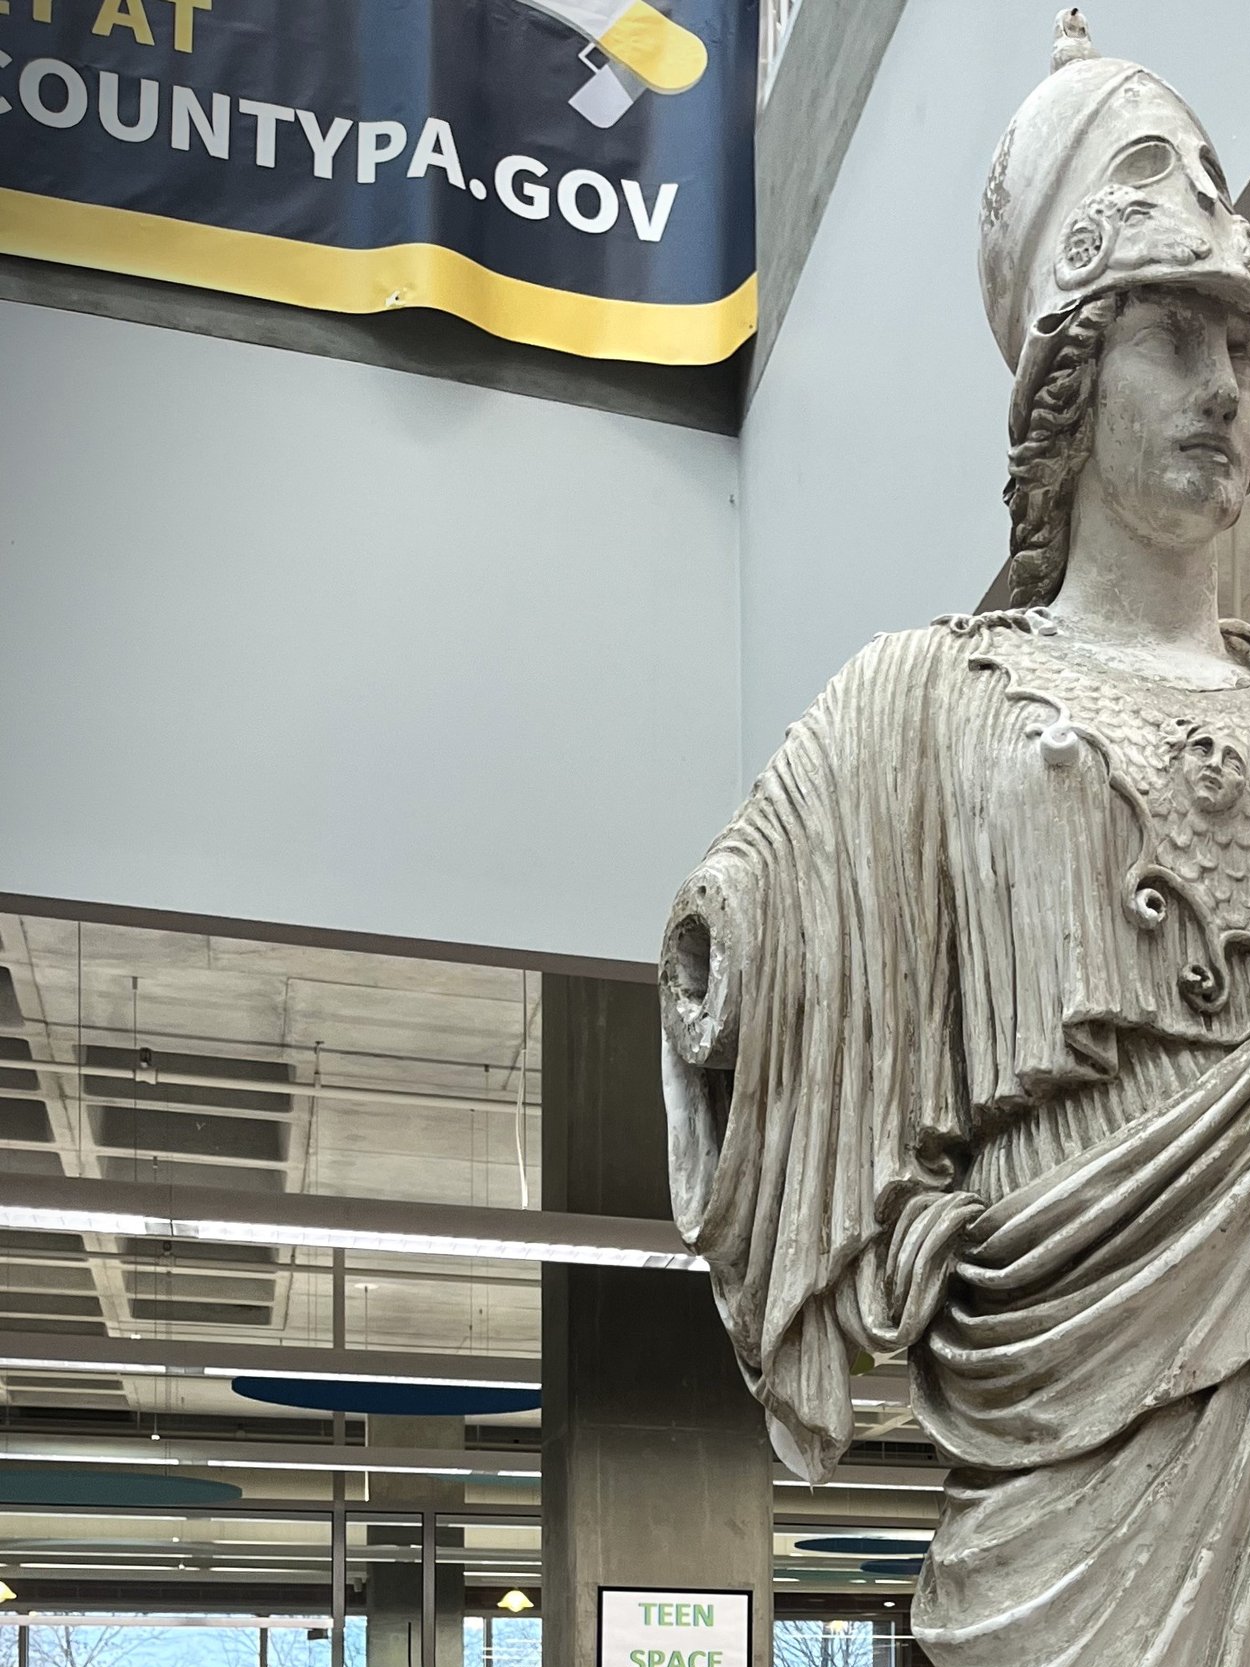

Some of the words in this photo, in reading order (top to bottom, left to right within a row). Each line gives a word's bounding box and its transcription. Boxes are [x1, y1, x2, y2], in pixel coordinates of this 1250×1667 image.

[92, 0, 212, 53] AT
[0, 50, 679, 243] OUNTYPA.GOV
[638, 1602, 714, 1627] TEEN
